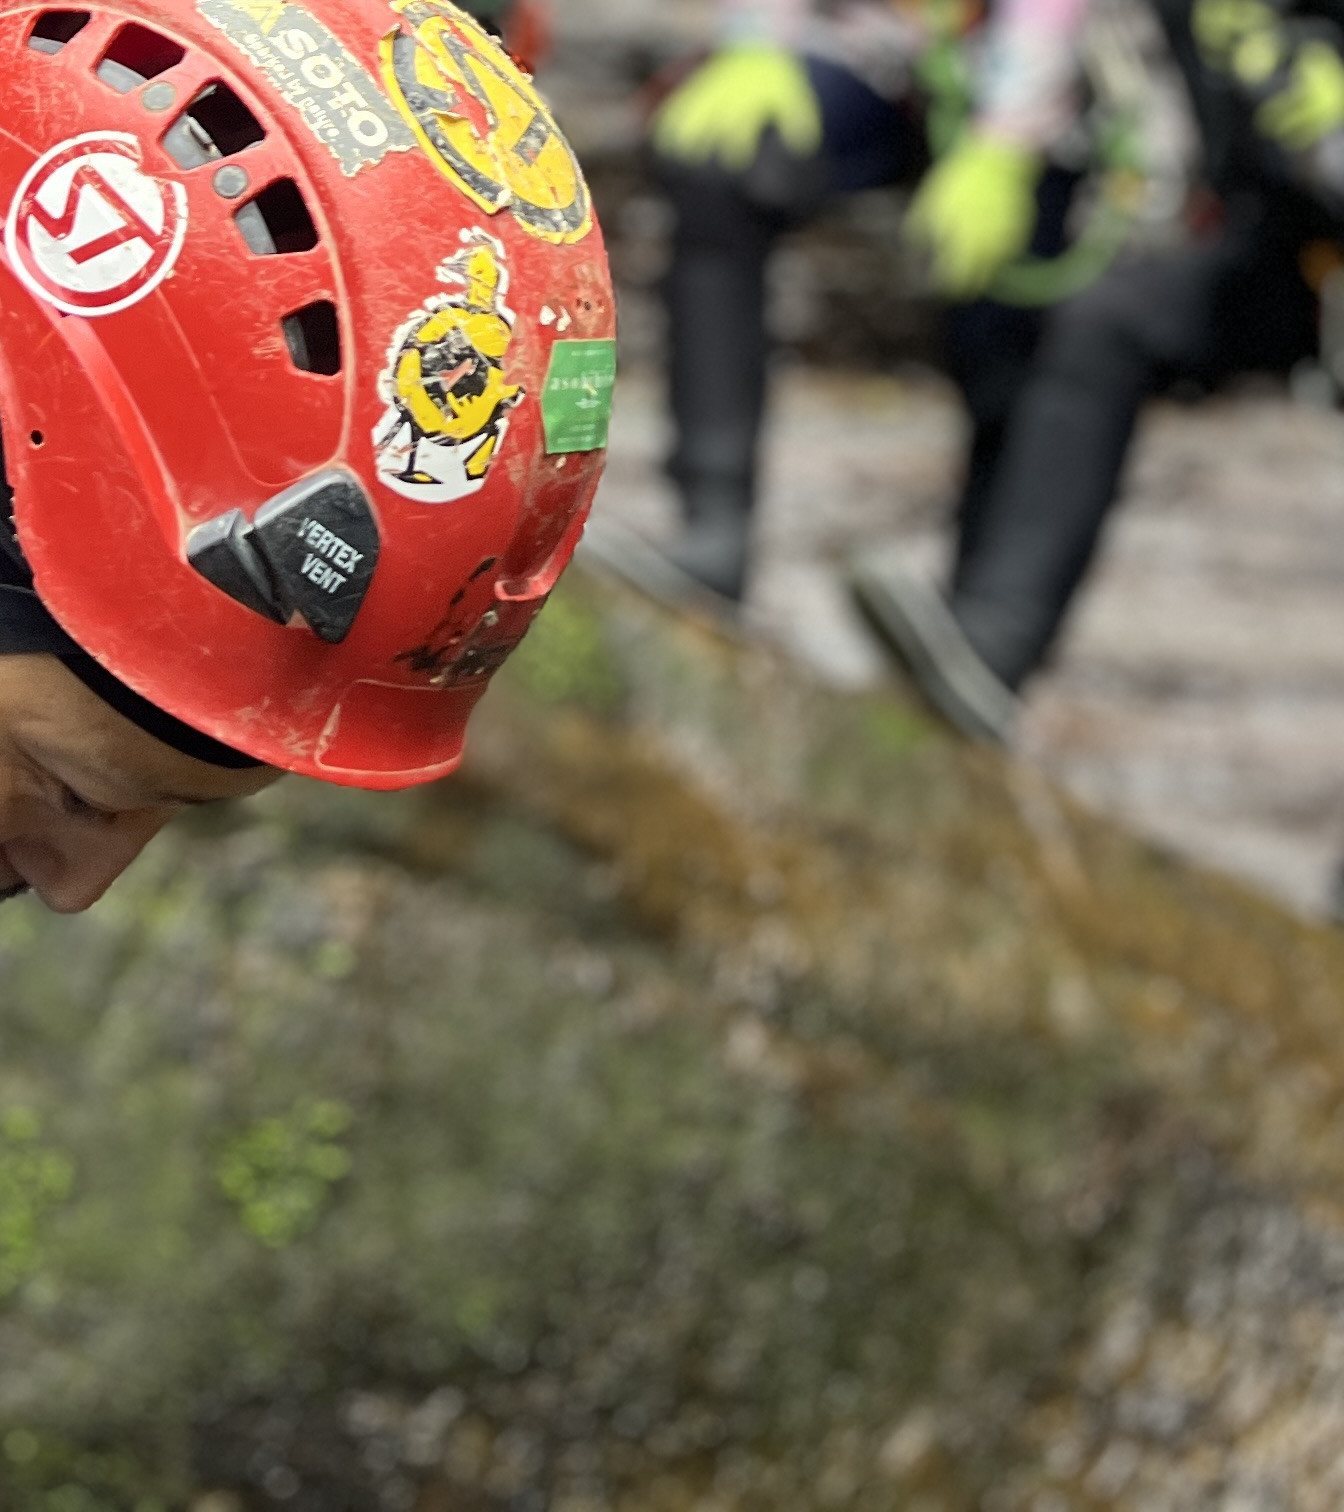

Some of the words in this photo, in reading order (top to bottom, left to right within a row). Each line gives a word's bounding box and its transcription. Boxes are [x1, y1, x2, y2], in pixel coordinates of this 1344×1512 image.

[267, 29, 388, 146] SOTO
[297, 517, 364, 573] VERTEX
[301, 553, 347, 594] VENT
